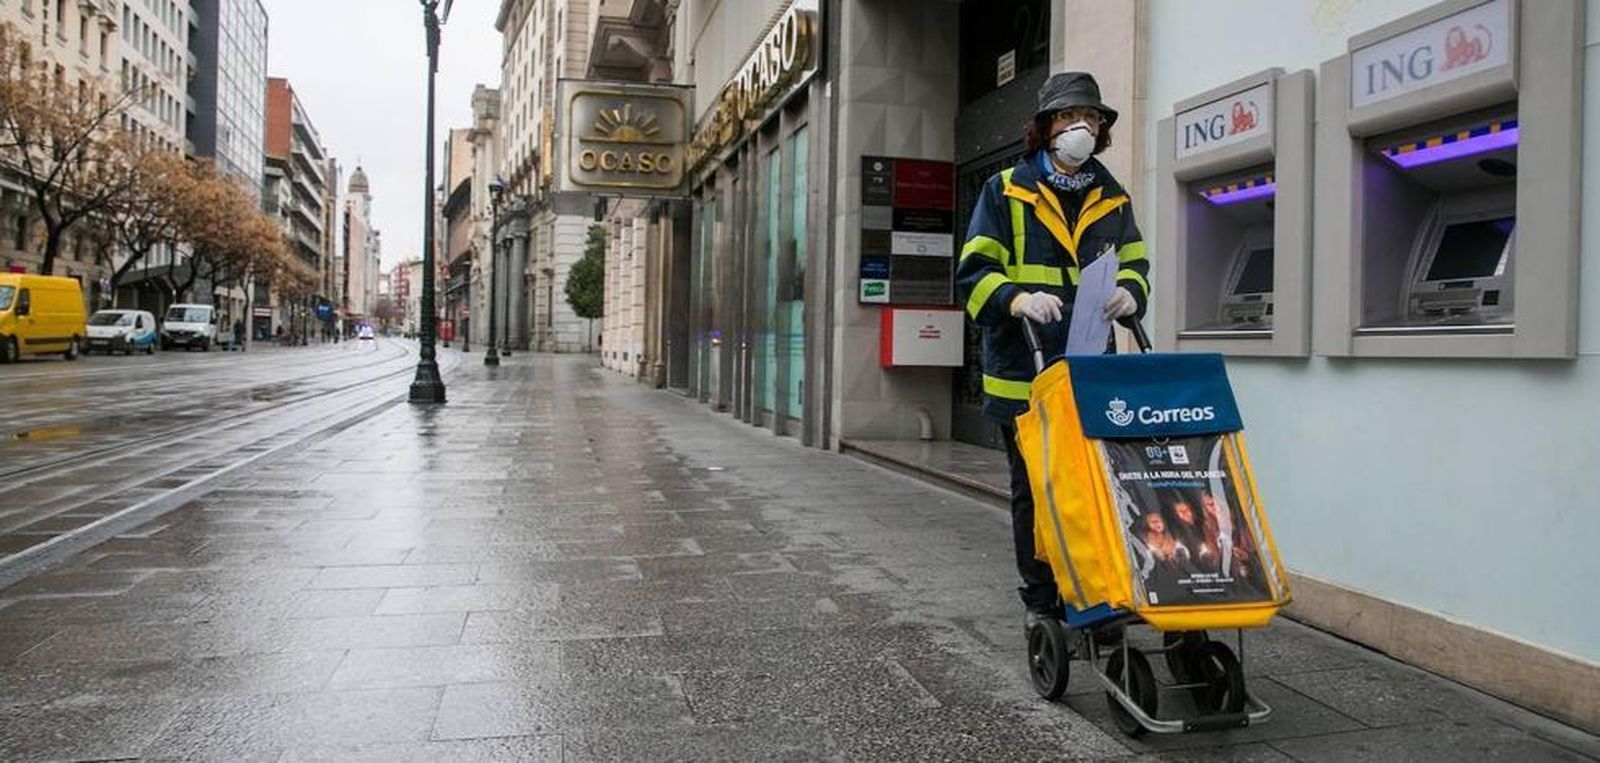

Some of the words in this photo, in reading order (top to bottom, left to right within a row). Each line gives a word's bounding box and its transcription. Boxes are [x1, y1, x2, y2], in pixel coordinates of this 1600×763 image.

[737, 4, 797, 121] OCASO
[1366, 45, 1433, 95] ING
[1185, 114, 1226, 149] ING
[580, 149, 674, 172] OCASO
[1138, 406, 1215, 424] Correos
